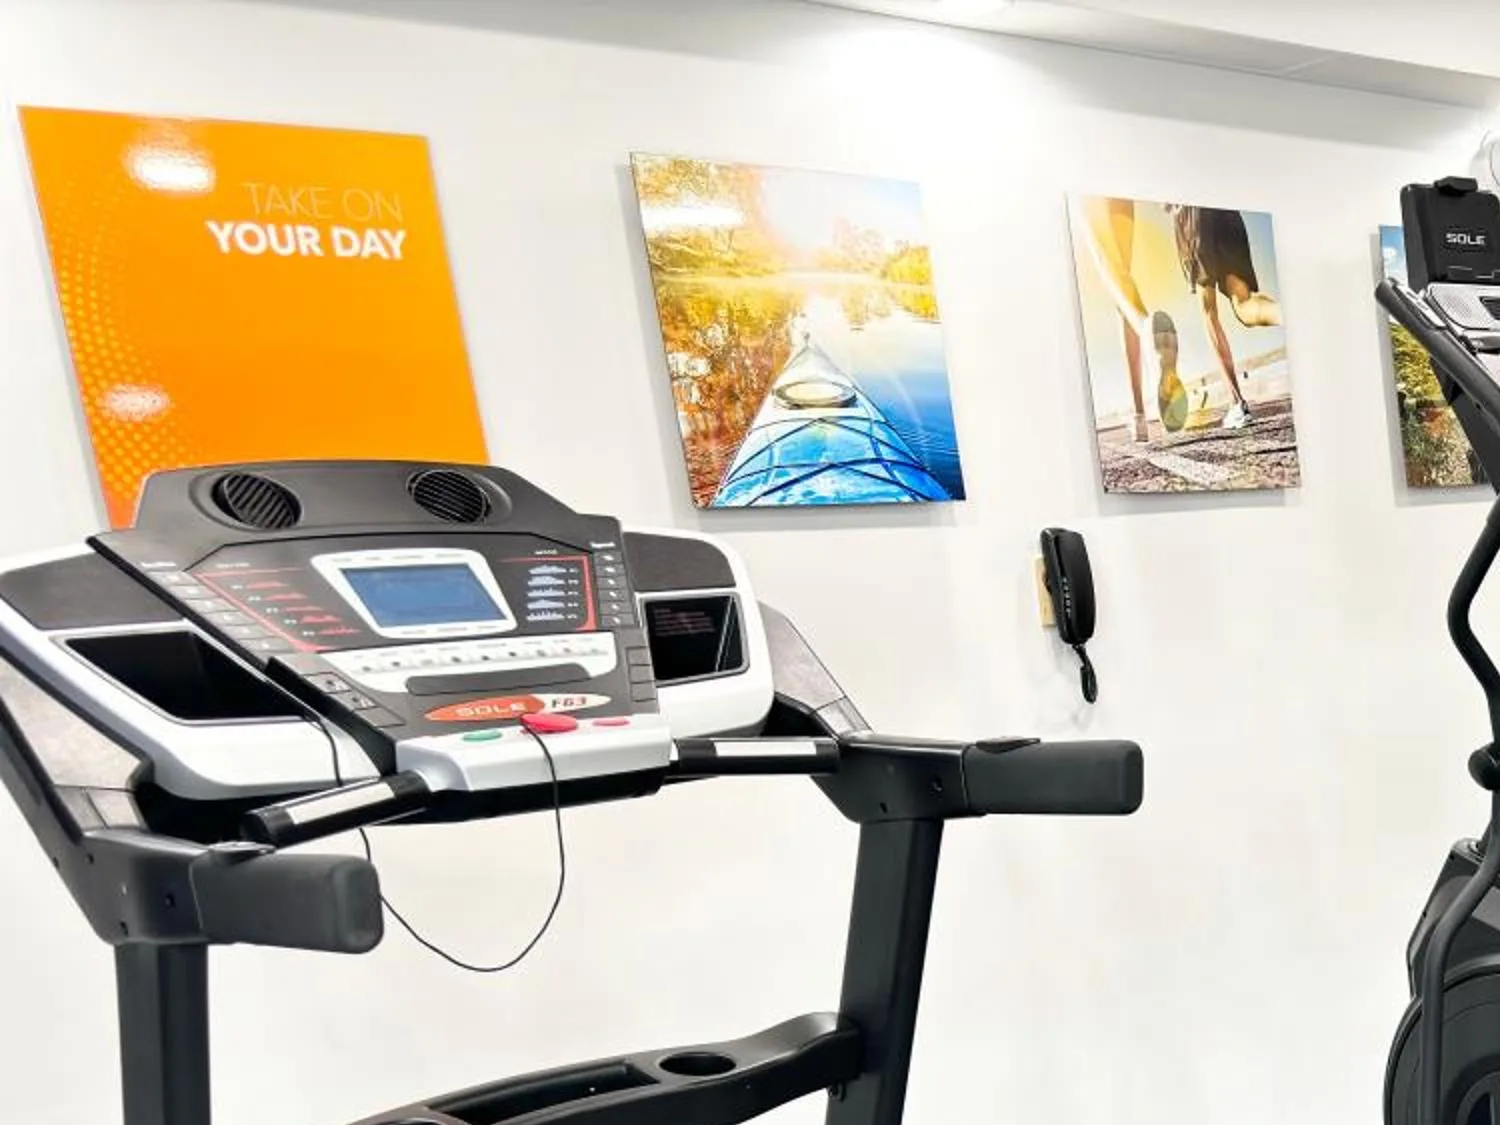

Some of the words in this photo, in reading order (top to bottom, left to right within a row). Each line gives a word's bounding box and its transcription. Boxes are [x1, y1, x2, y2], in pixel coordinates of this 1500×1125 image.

[241, 181, 335, 220] TAKE
[342, 187, 403, 223] ON
[206, 219, 325, 257] YOUR
[330, 225, 406, 261] DAY
[1446, 232, 1486, 245] SOLE
[455, 702, 528, 717] SOLE
